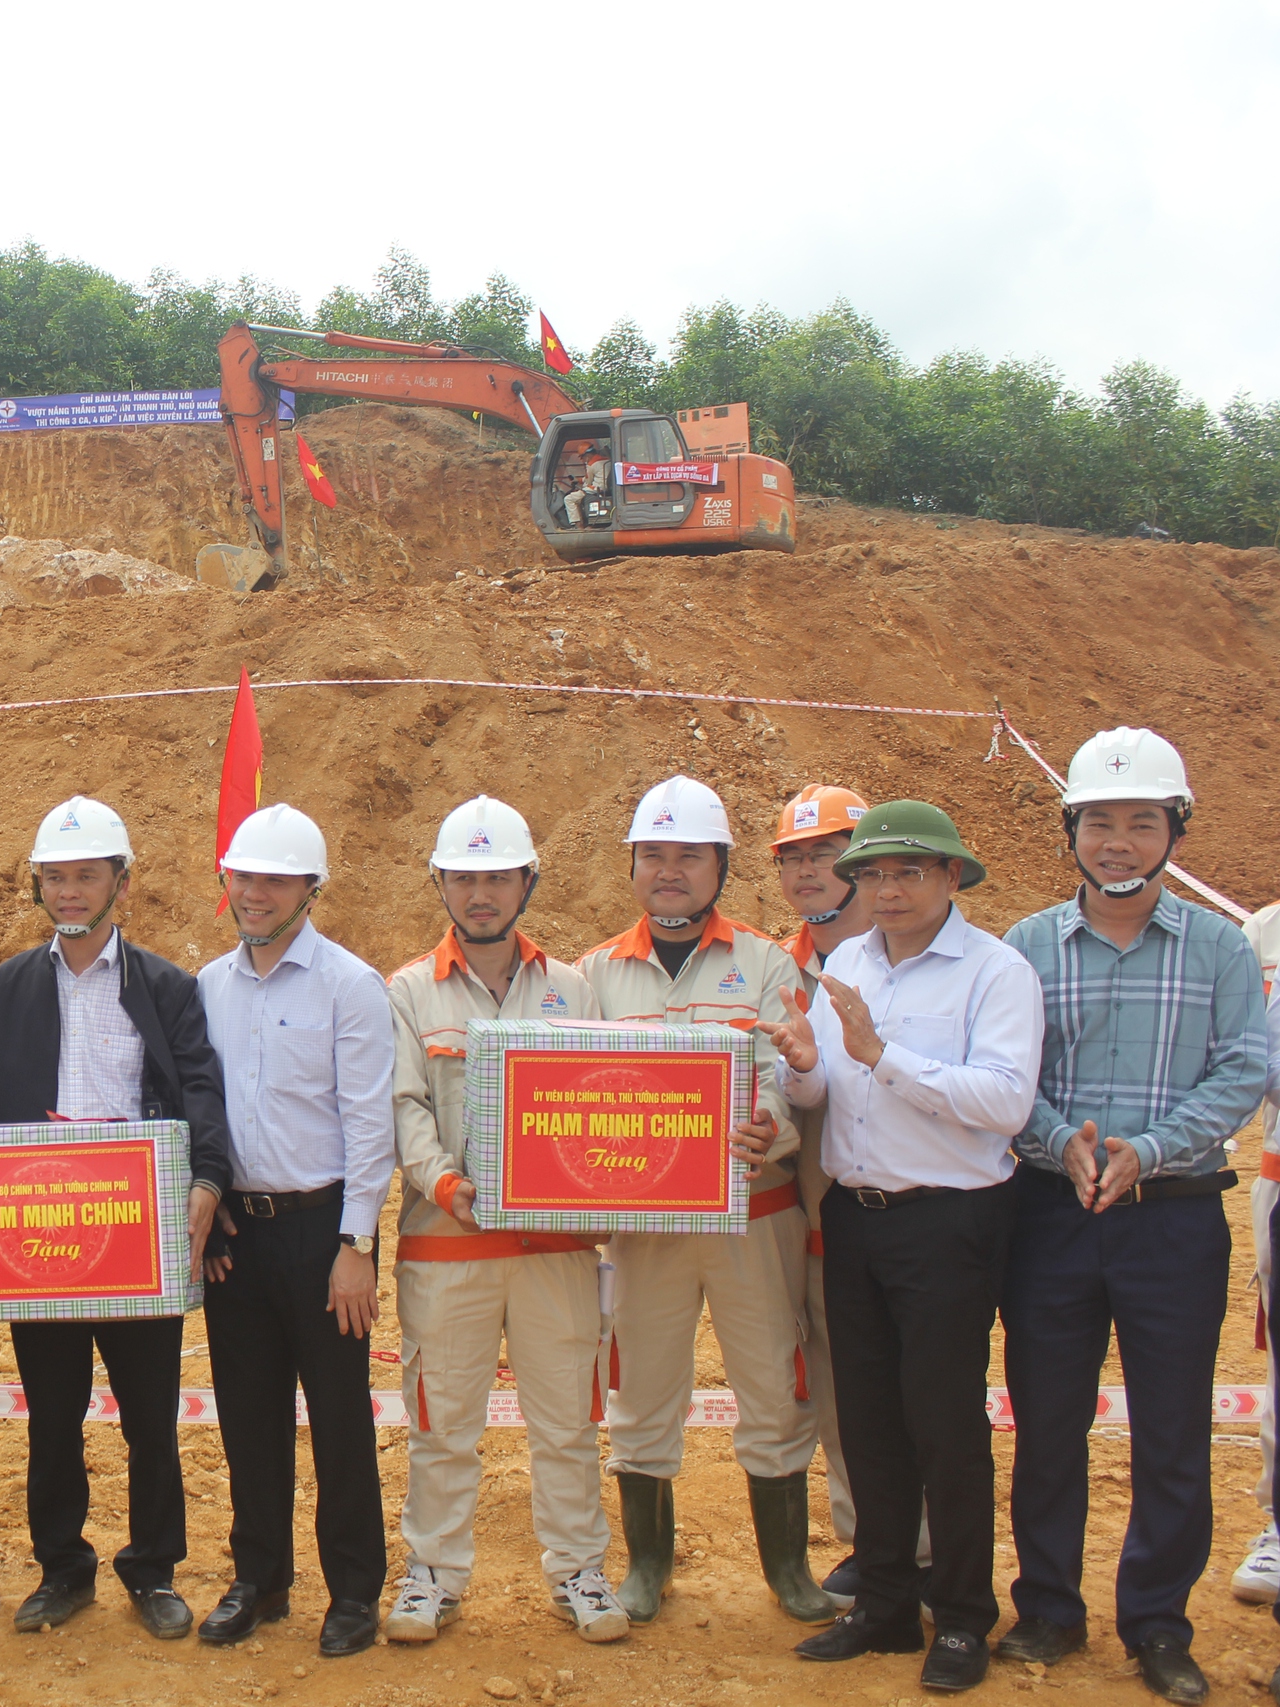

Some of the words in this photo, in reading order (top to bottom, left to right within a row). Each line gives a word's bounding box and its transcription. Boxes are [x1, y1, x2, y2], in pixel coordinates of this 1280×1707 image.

[316, 371, 369, 383] HITACHI
[134, 392, 160, 401] KHÔNG
[133, 403, 158, 412] TRANH
[36, 419, 48, 427] THI
[50, 417, 70, 426] CÔNG
[72, 417, 77, 425] 3
[79, 416, 91, 425] CA,
[93, 416, 99, 424] 4
[137, 412, 155, 423] VIỆC
[156, 411, 182, 421] XUYÊN
[704, 497, 732, 509] ZAXIS
[704, 509, 732, 519] 225
[534, 1087, 544, 1102] ỦY
[545, 1089, 563, 1102] VIÊN
[565, 1089, 575, 1105] BỘ
[577, 1090, 601, 1103] CHÍNH
[619, 1088, 633, 1104] THỦ
[661, 1091, 684, 1104] CHÍNH
[686, 1089, 702, 1104] PHỦ
[522, 1113, 582, 1142] PHẠM
[589, 1113, 644, 1138] MINH
[650, 1110, 713, 1138] CHÍNH
[585, 1148, 649, 1173] Tặng
[0, 1184, 9, 1198] BỘ
[11, 1183, 33, 1196] CHÍNH
[49, 1179, 63, 1194] THỦ
[90, 1180, 112, 1192] CHÍNH
[114, 1176, 129, 1191] PHỦ
[23, 1203, 75, 1228] MINH
[81, 1198, 142, 1226] CHÍNH
[21, 1239, 82, 1262] Tặng
